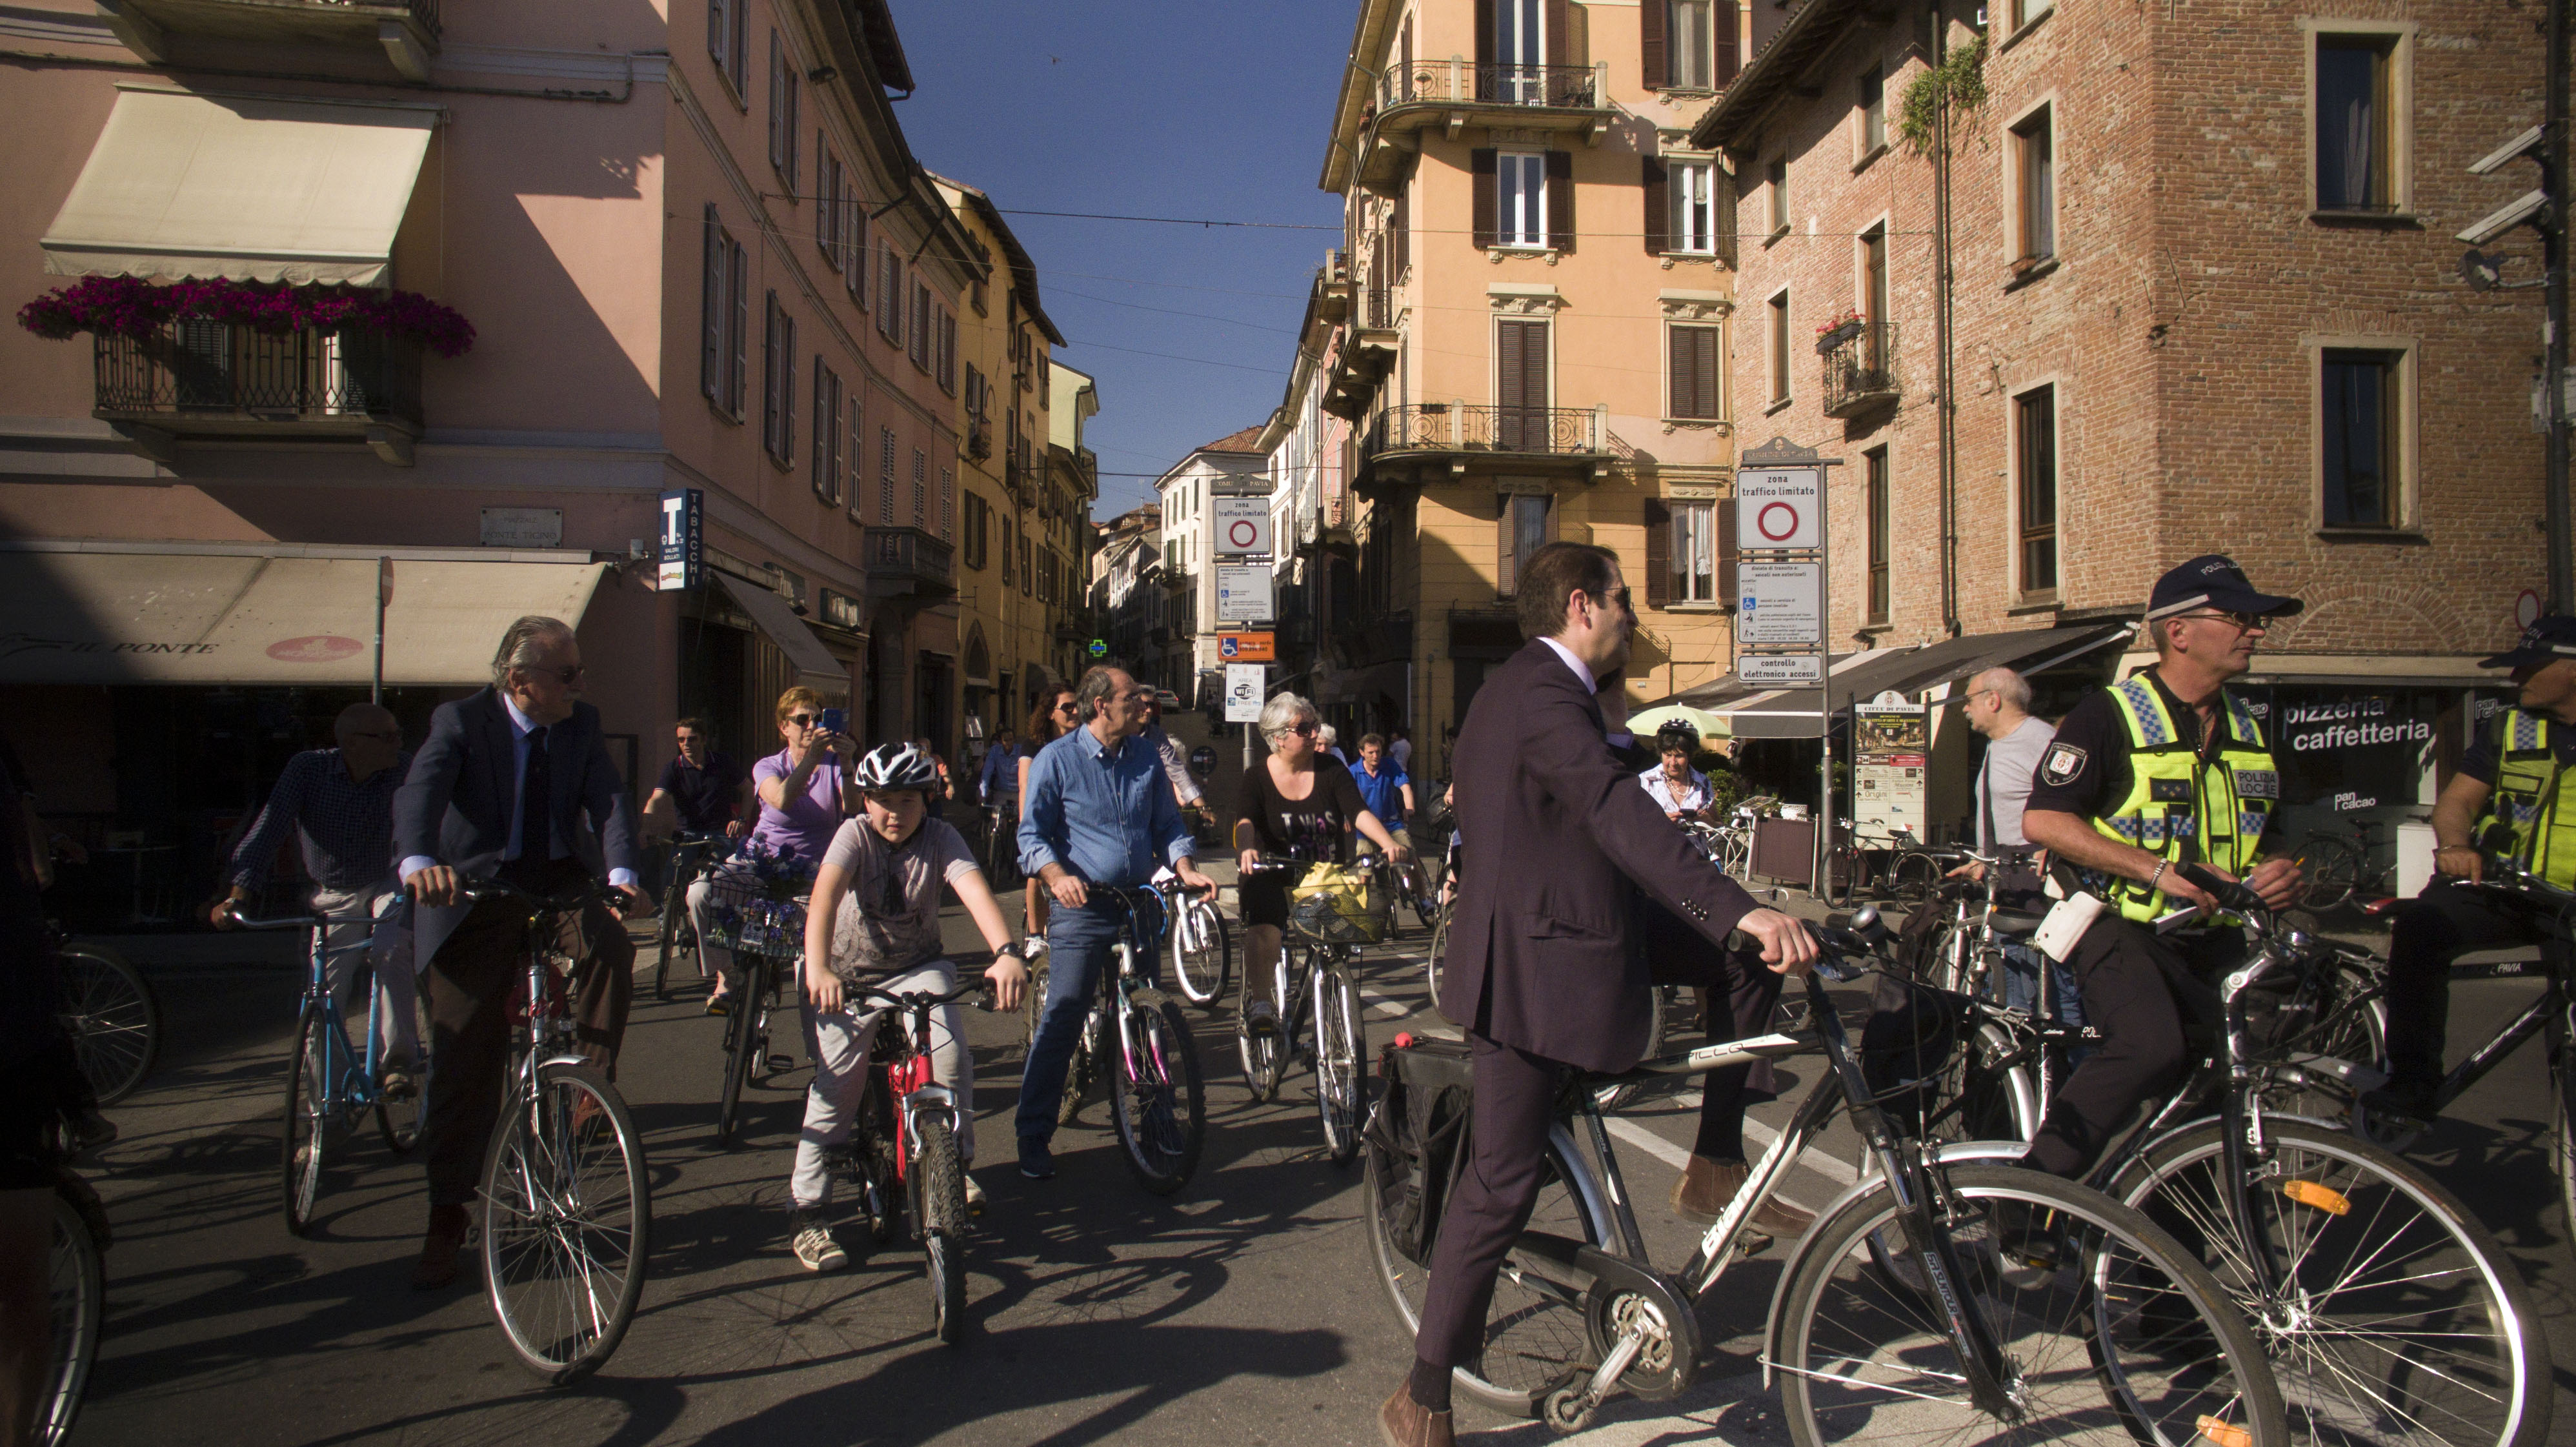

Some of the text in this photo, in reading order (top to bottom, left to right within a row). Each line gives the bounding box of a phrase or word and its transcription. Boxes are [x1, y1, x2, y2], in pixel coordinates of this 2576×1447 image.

[1742, 486, 1815, 496] traffico limitato
[663, 497, 682, 545] T
[485, 531, 518, 540] PONTE
[689, 493, 699, 586] TABACCHI
[112, 642, 220, 654] PONTE
[1761, 658, 1796, 667] controllo
[2282, 696, 2385, 741] pizzeria
[2293, 718, 2430, 751] caffetteria
[2239, 773, 2276, 783] POLIZIA
[2240, 783, 2277, 794] LOCALE
[2335, 792, 2356, 811] pan
[2341, 798, 2376, 810] cacao
[2497, 963, 2522, 973] PAVIA
[1933, 1270, 1959, 1315] SUNTOUR
